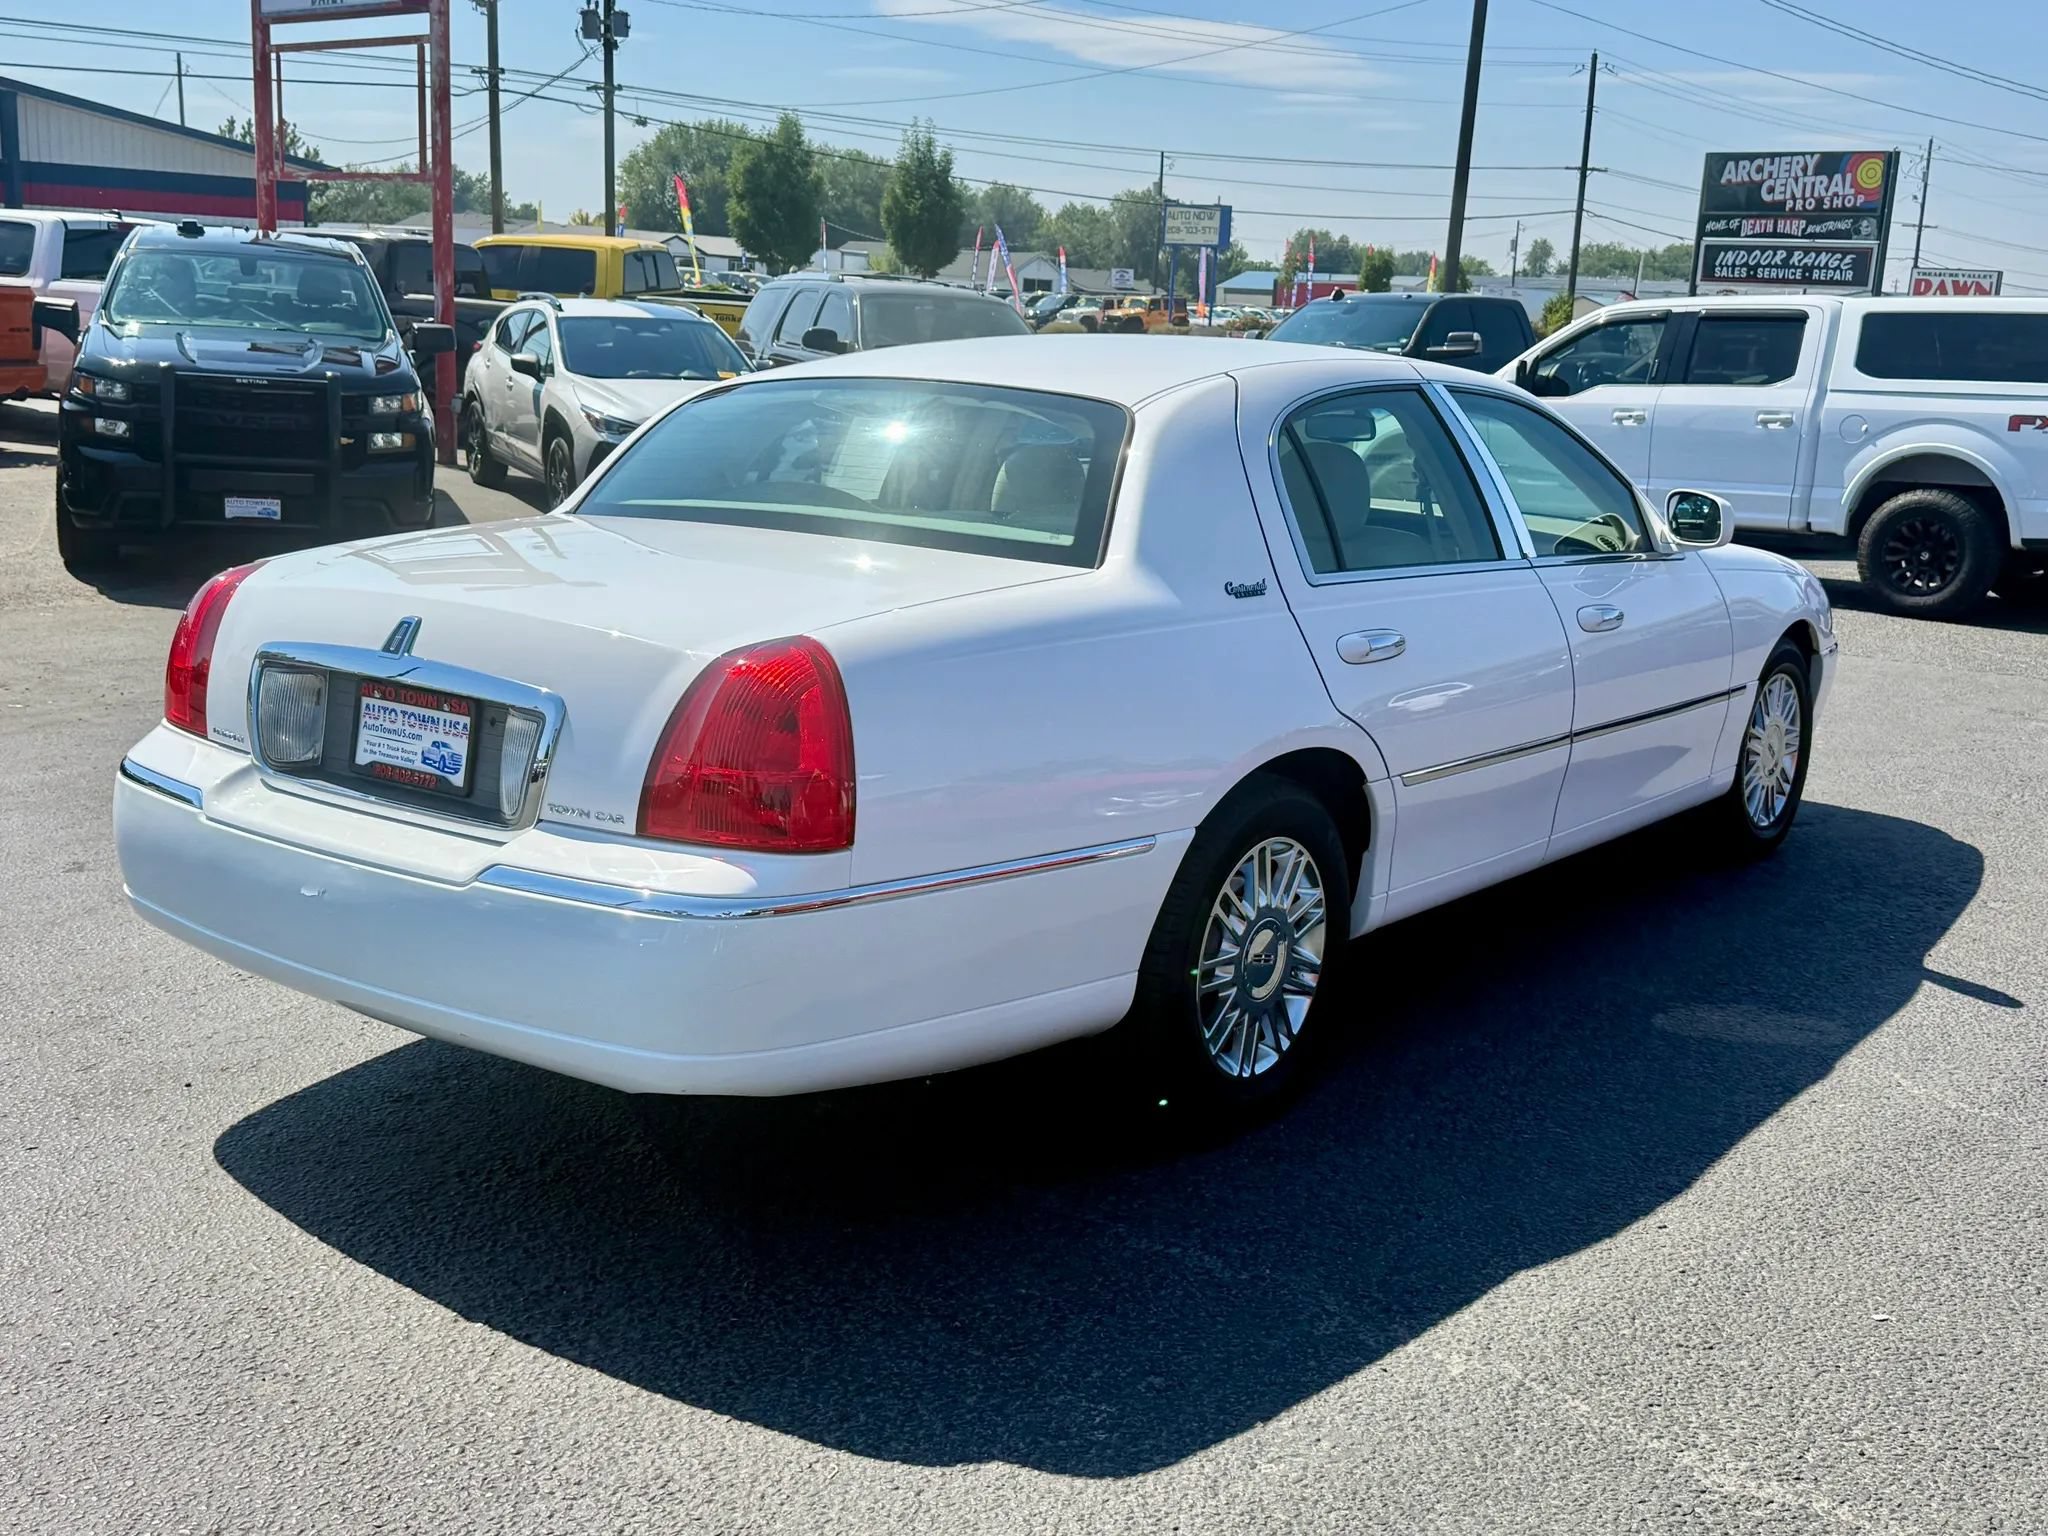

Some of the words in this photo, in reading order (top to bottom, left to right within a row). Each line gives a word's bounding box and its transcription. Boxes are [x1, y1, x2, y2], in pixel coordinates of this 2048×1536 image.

[1721, 154, 1821, 184] ARCHERY
[1760, 173, 1856, 202] CENTRAL
[1785, 199, 1816, 212] PRO
[1823, 195, 1866, 209] SHOP
[1168, 210, 1191, 221] AUTO
[1192, 211, 1217, 221] NOW
[1705, 219, 1728, 233] HOME
[1729, 218, 1742, 230] OF
[1740, 219, 1774, 237] DEATH
[1777, 219, 1807, 237] HARP
[1715, 250, 1787, 267] INDOOR
[1789, 251, 1857, 270] RANGE
[1714, 266, 1747, 278] SALES
[1756, 268, 1803, 280] SERVICE
[1812, 269, 1854, 281] REPAIR
[361, 682, 396, 700] AUTO
[400, 688, 439, 709] TOWN
[363, 703, 399, 725] AUTO
[400, 709, 441, 734] TOWN
[442, 718, 470, 740] USA
[363, 721, 423, 741] AutoTownUS.com
[547, 803, 591, 819] TOWN
[594, 811, 625, 825] CAR
